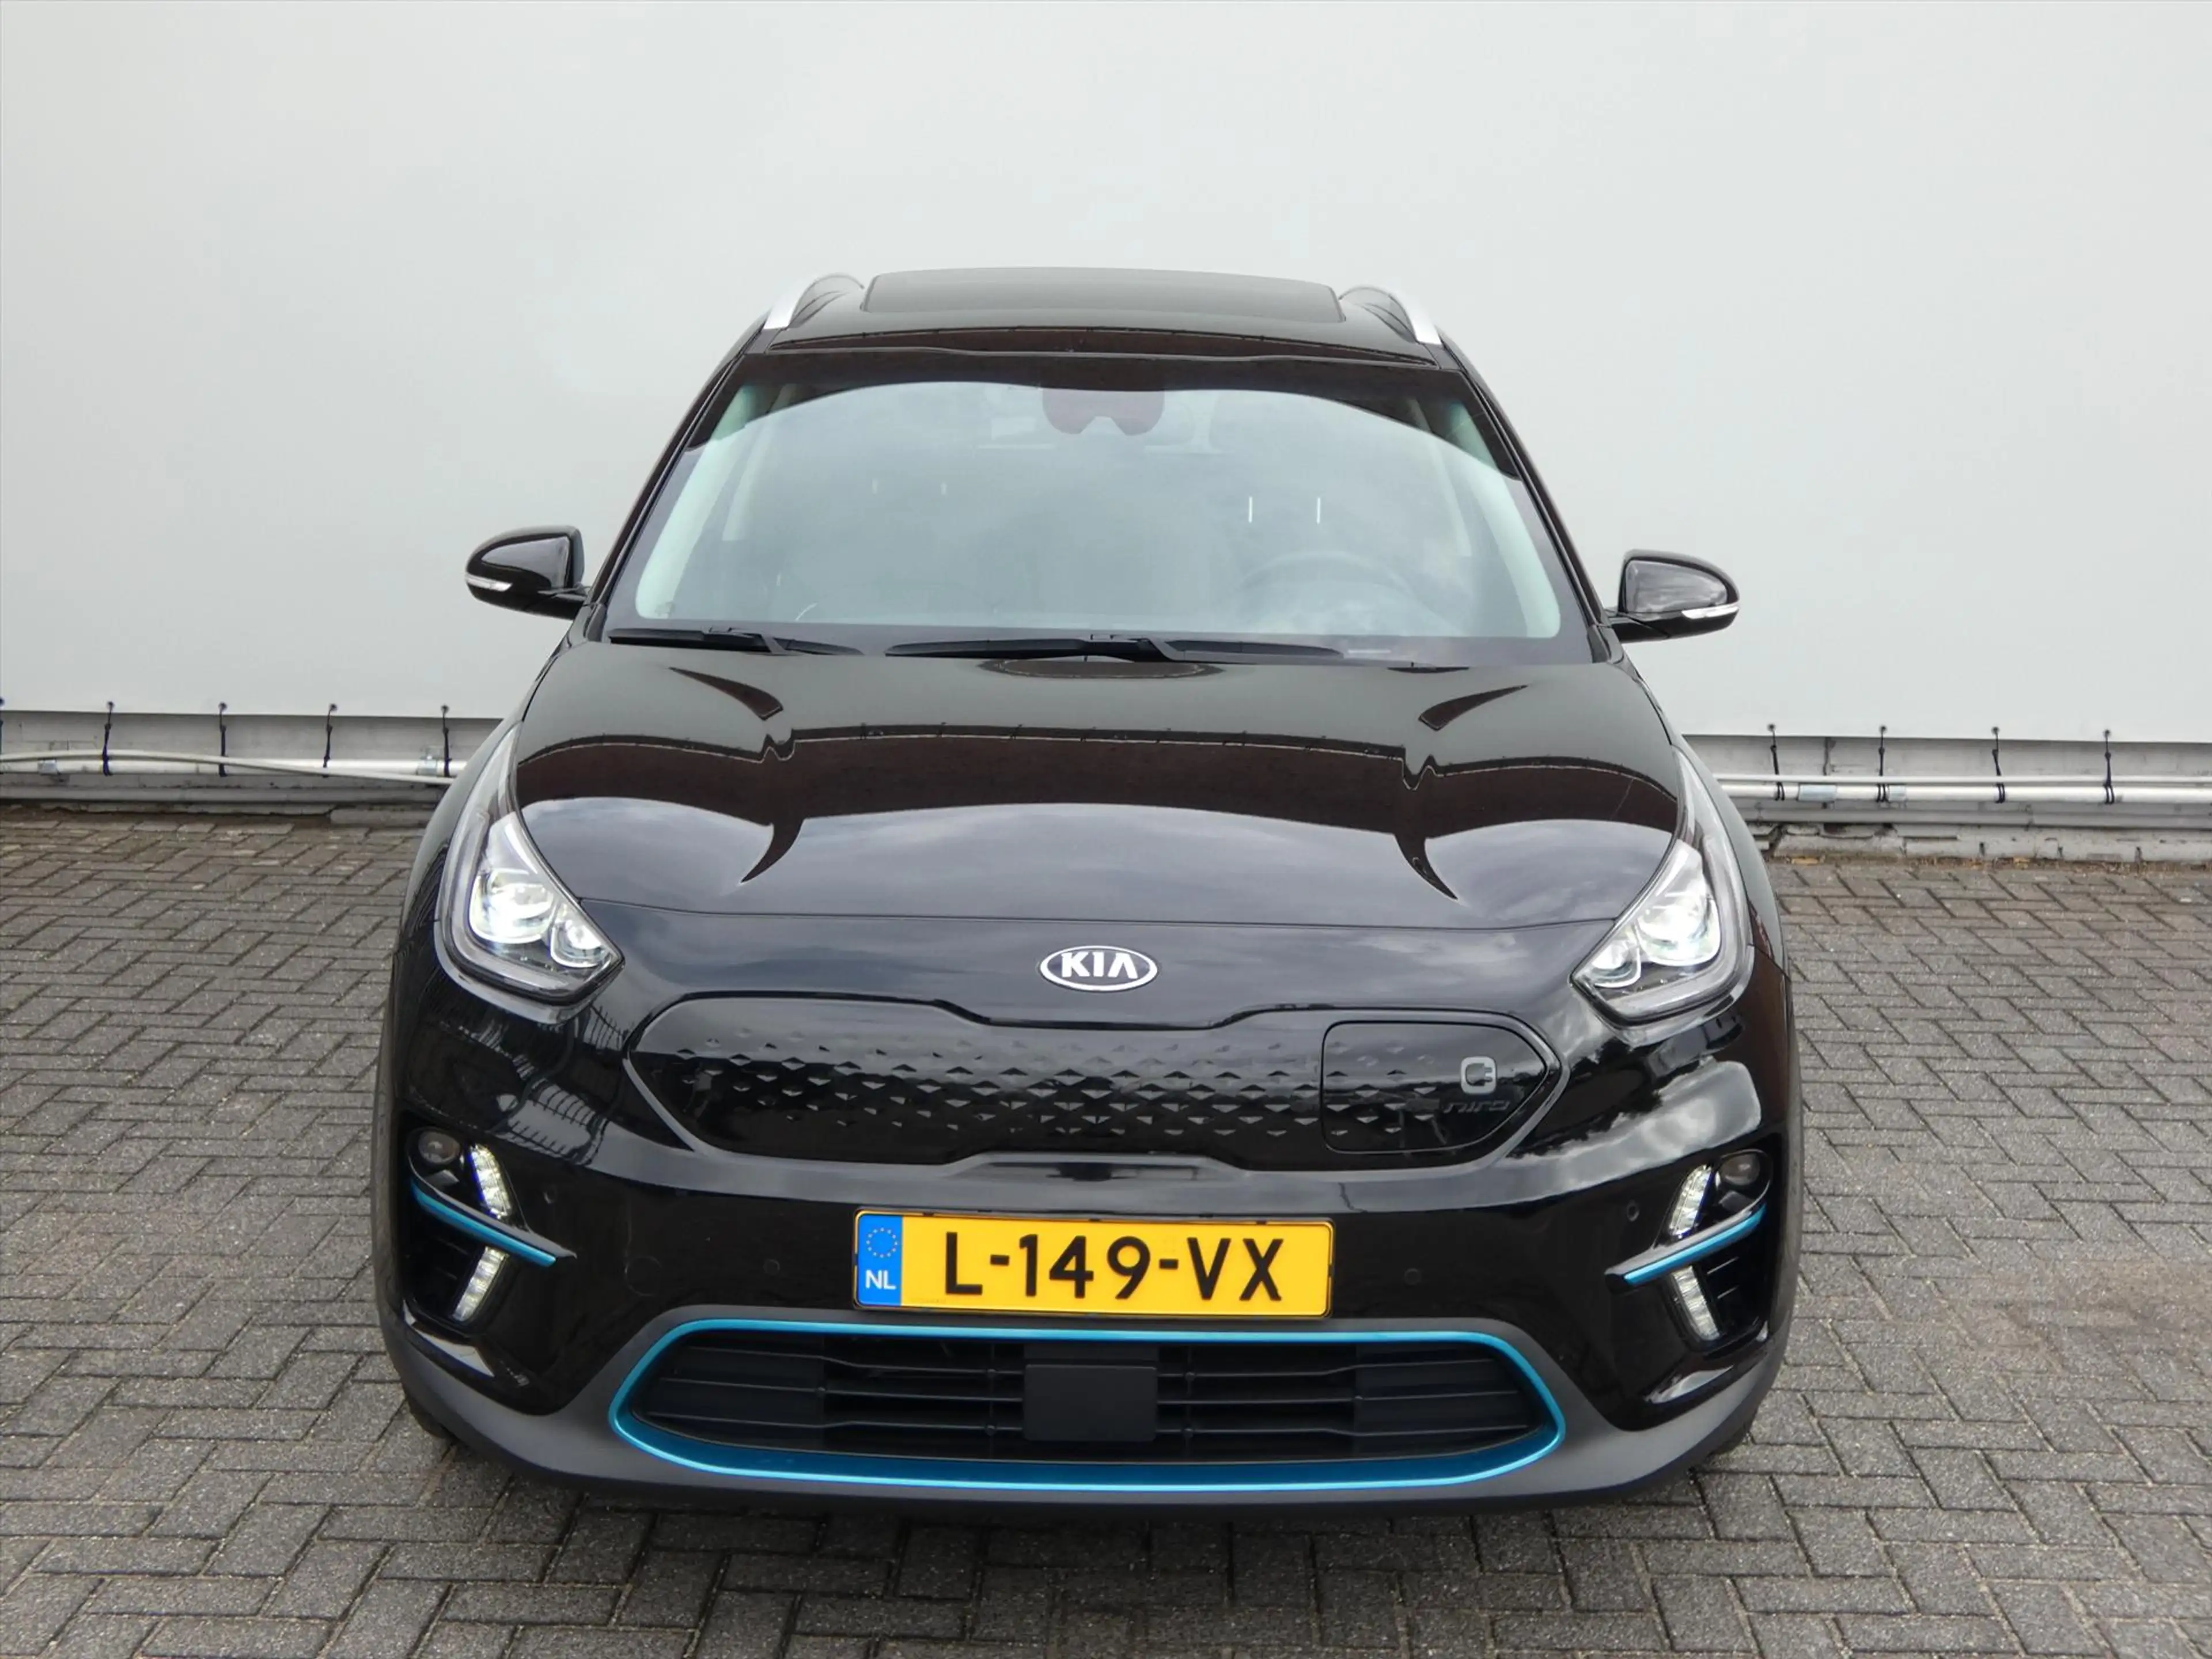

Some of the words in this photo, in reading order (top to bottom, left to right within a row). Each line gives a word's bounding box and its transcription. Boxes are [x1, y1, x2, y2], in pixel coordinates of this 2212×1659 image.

[1061, 951, 1138, 979] KIA
[865, 1270, 896, 1290] NL
[945, 1232, 1284, 1301] L-149-VX
